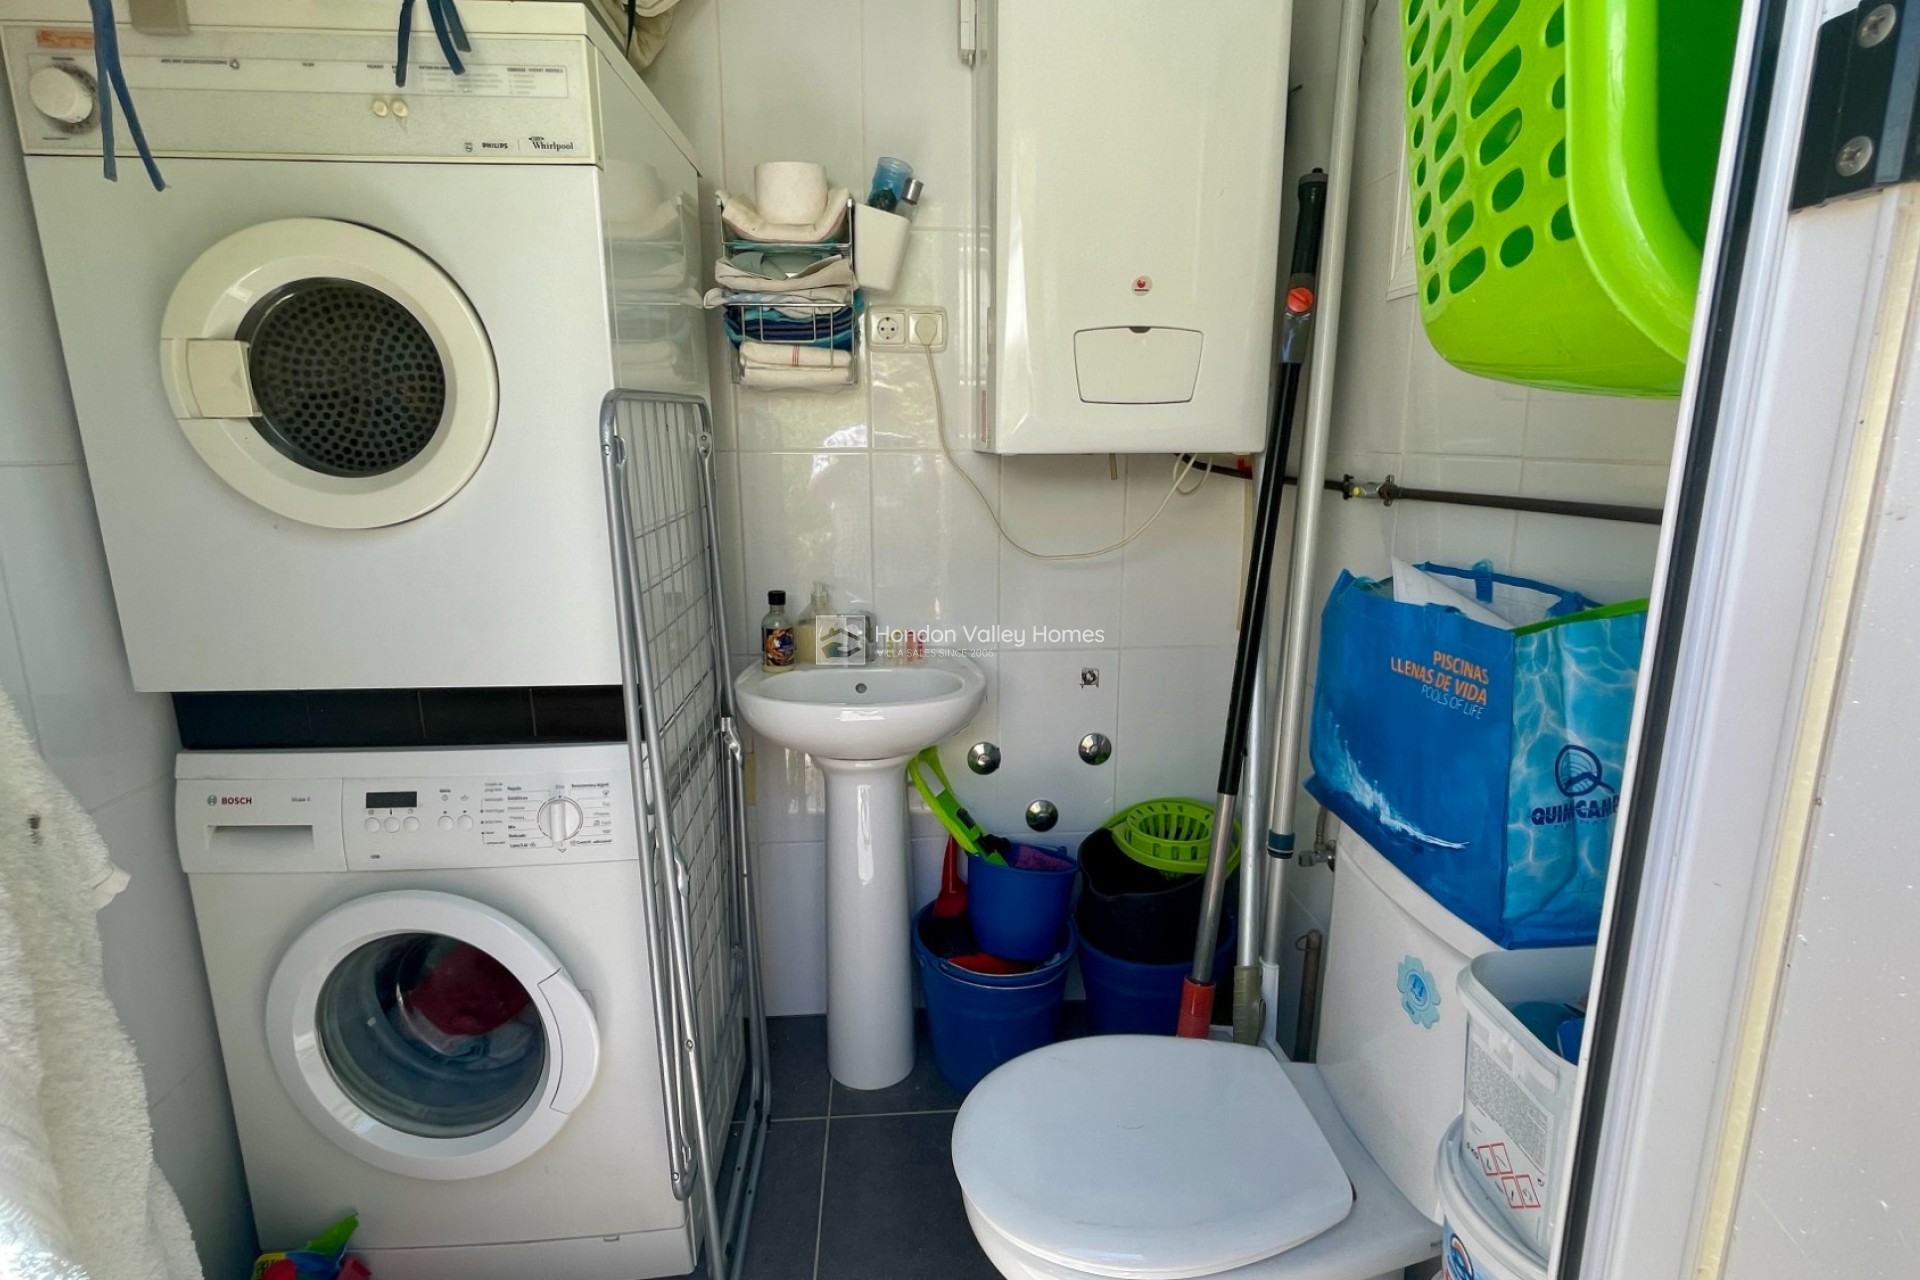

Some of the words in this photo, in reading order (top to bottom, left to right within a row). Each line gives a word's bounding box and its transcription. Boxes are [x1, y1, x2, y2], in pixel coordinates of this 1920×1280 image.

[482, 142, 509, 150] PHILIPS
[532, 141, 574, 151] Whirlpool
[1433, 650, 1489, 685] PISCINAS
[1390, 656, 1435, 685] LLENAS
[1435, 672, 1452, 692] DE
[1455, 678, 1488, 706] VIDA
[1421, 684, 1449, 706] POOLS
[1448, 696, 1464, 710] OF
[1463, 701, 1485, 720] LIFE
[221, 797, 253, 806] BOSCH
